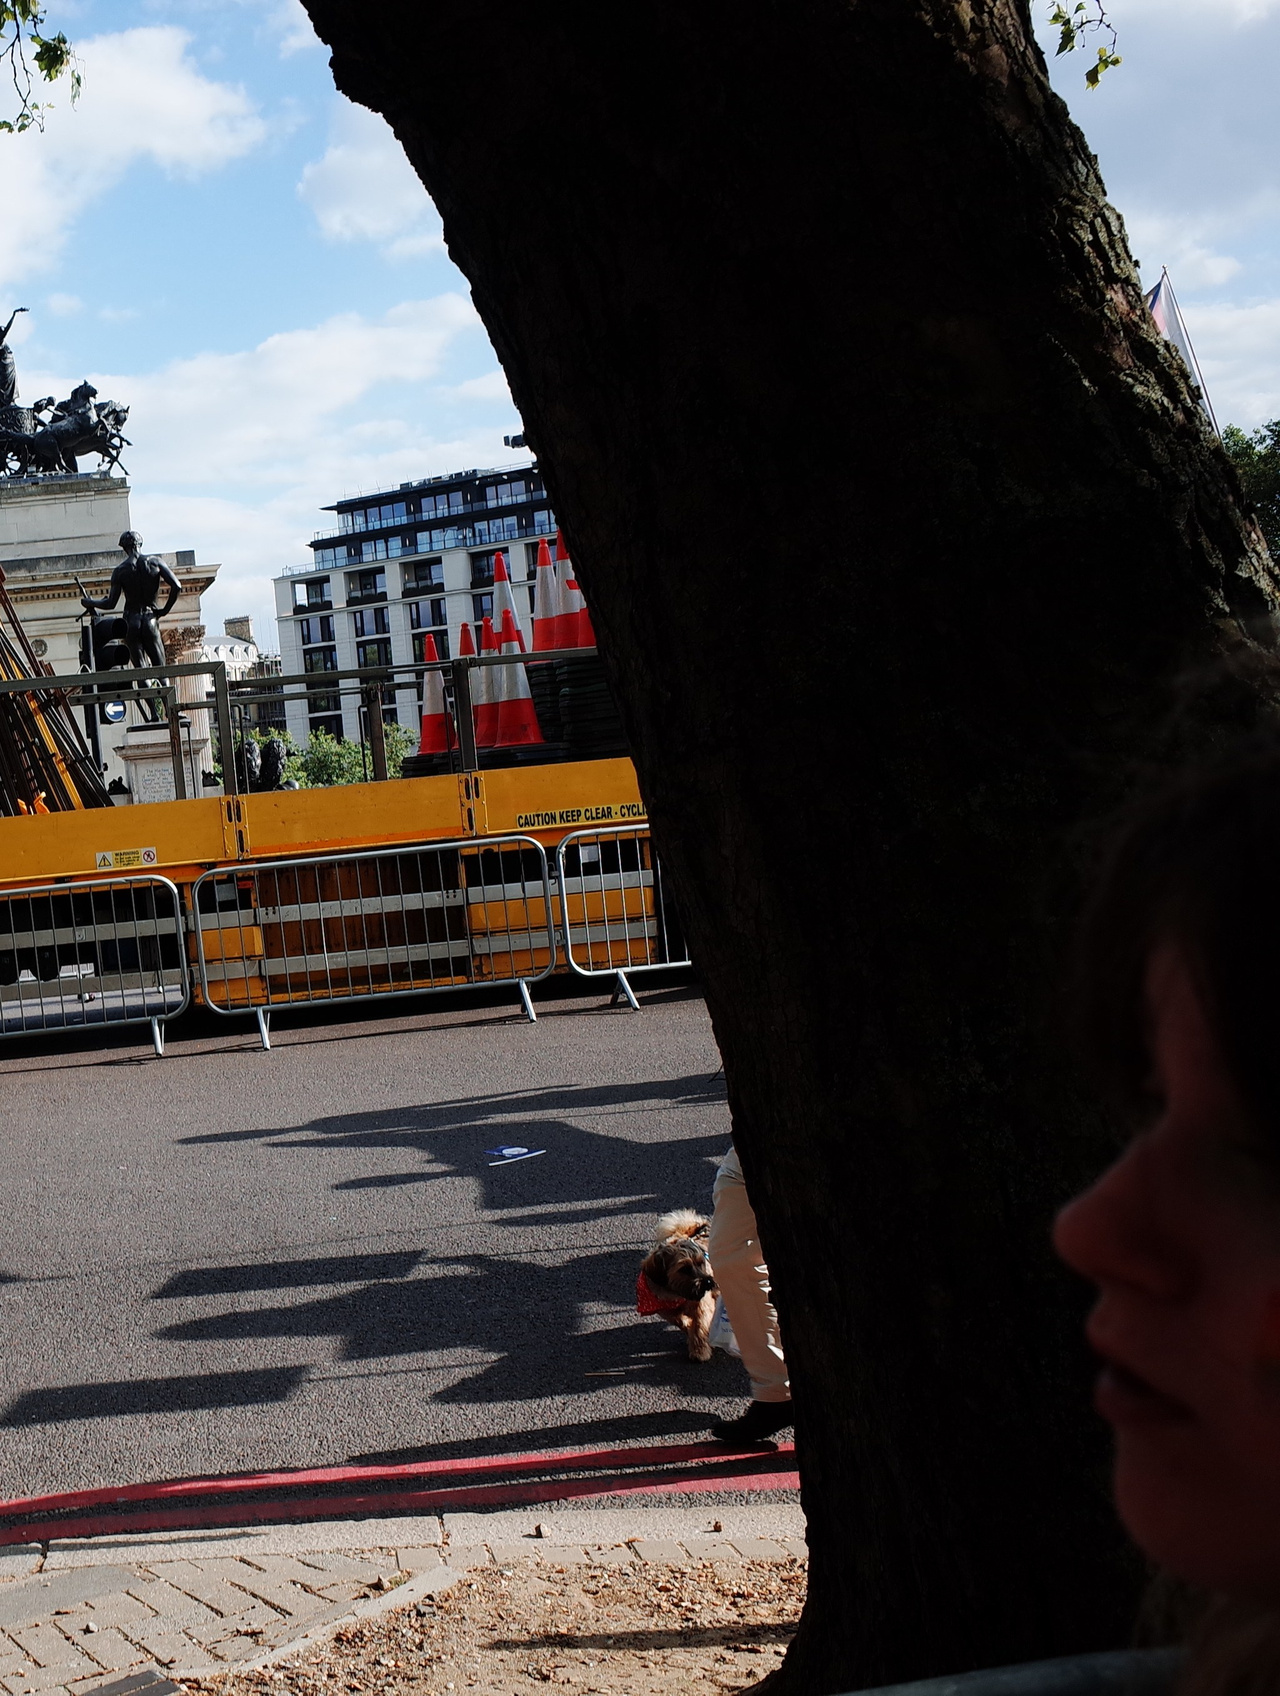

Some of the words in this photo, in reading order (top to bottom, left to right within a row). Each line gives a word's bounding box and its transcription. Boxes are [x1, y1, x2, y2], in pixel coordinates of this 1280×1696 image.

[517, 811, 557, 828] CAUTION
[558, 809, 582, 824] KEEP
[584, 806, 613, 821] CLEAR
